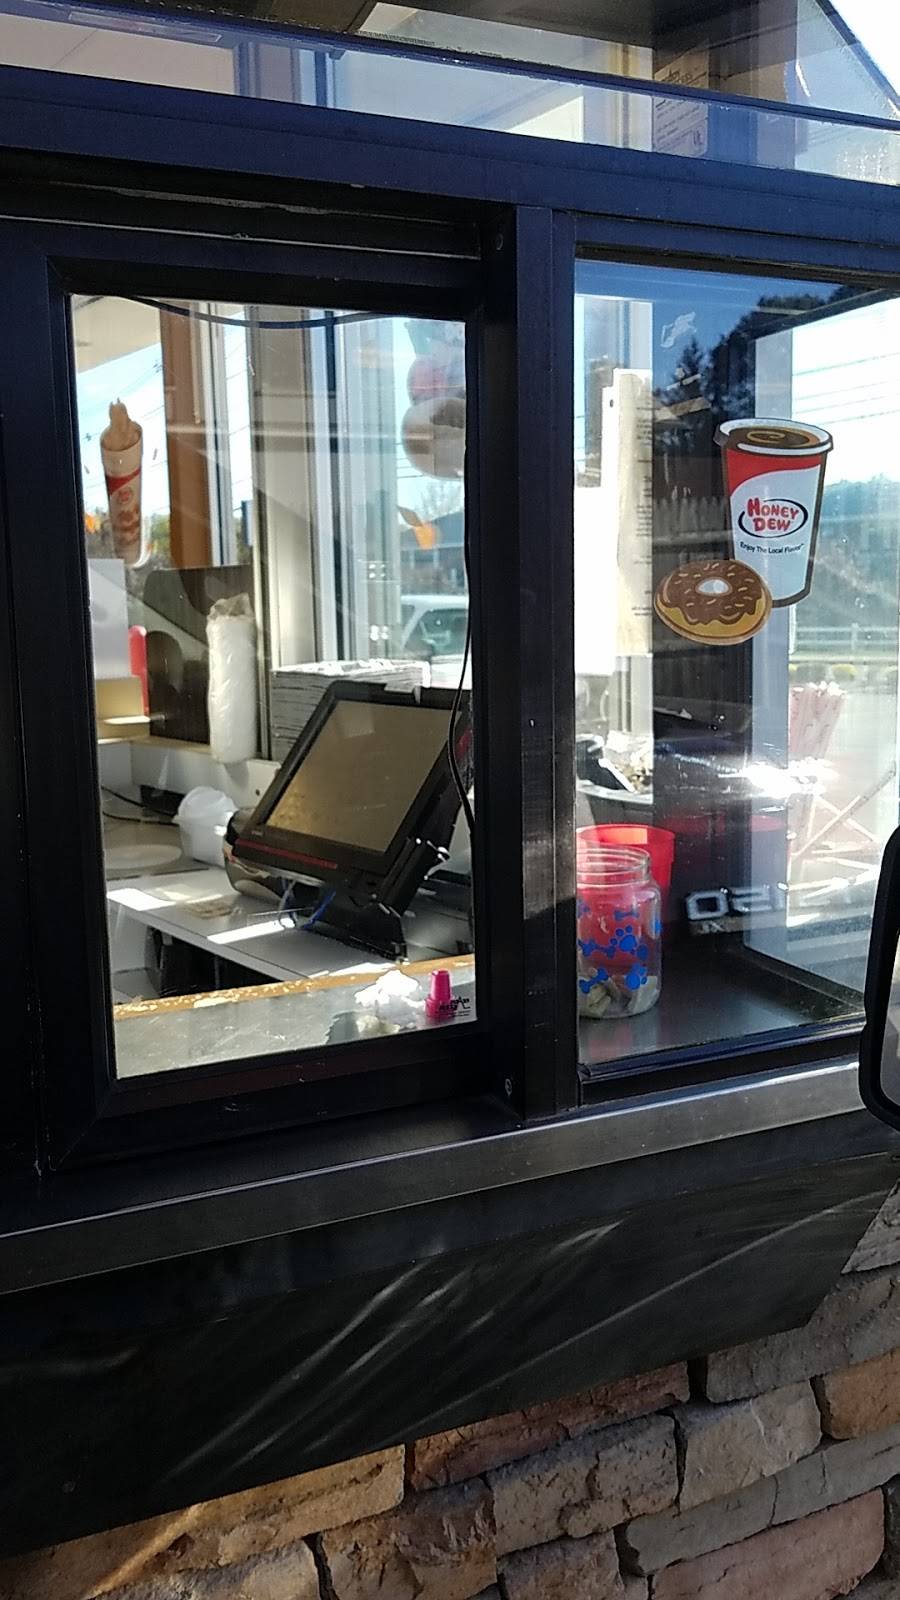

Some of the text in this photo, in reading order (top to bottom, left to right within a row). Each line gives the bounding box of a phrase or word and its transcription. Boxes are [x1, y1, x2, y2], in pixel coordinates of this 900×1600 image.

[747, 497, 800, 520] HONEY
[753, 517, 791, 532] DEW
[740, 541, 756, 552] Enjoy
